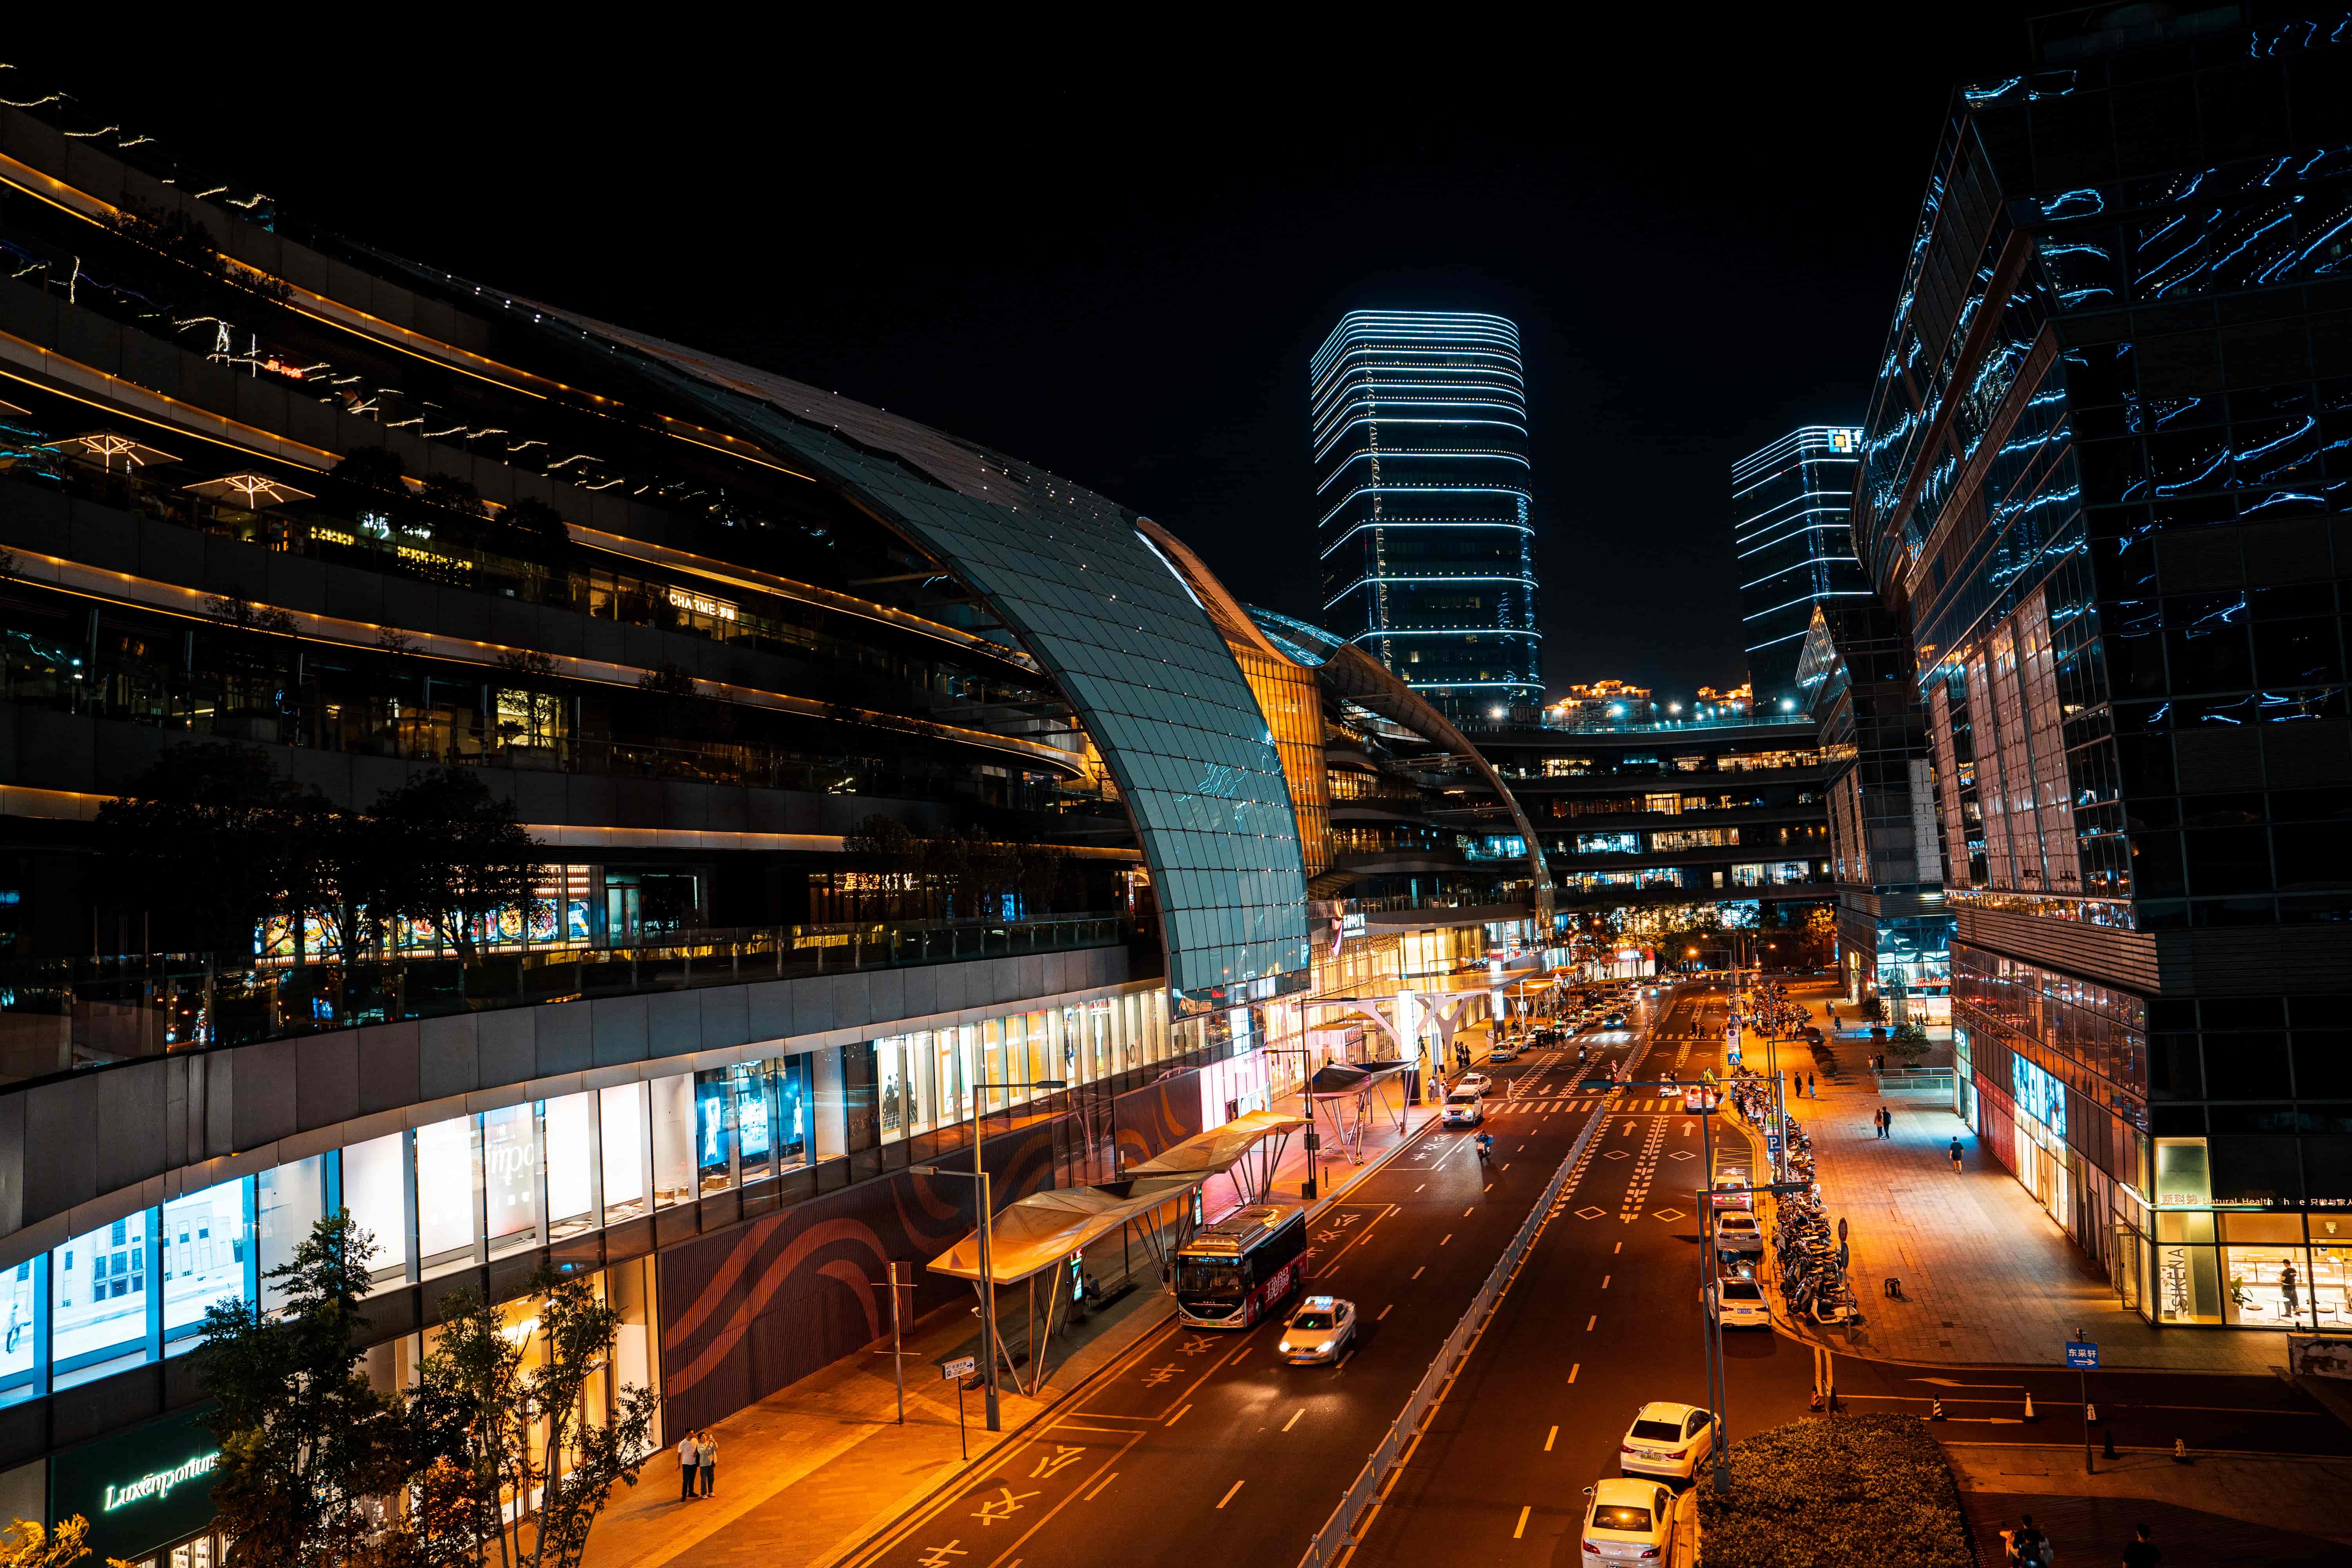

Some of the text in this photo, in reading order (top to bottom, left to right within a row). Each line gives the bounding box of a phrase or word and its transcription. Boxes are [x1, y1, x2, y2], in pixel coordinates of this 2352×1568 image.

[669, 593, 716, 616] CHARME
[1769, 1137, 1778, 1149] P
[2162, 1194, 2198, 1204] 斯科纳
[1840, 1222, 1847, 1237] 停
[2168, 1248, 2188, 1308] SIKENA
[2068, 1348, 2096, 1358] 东采轩
